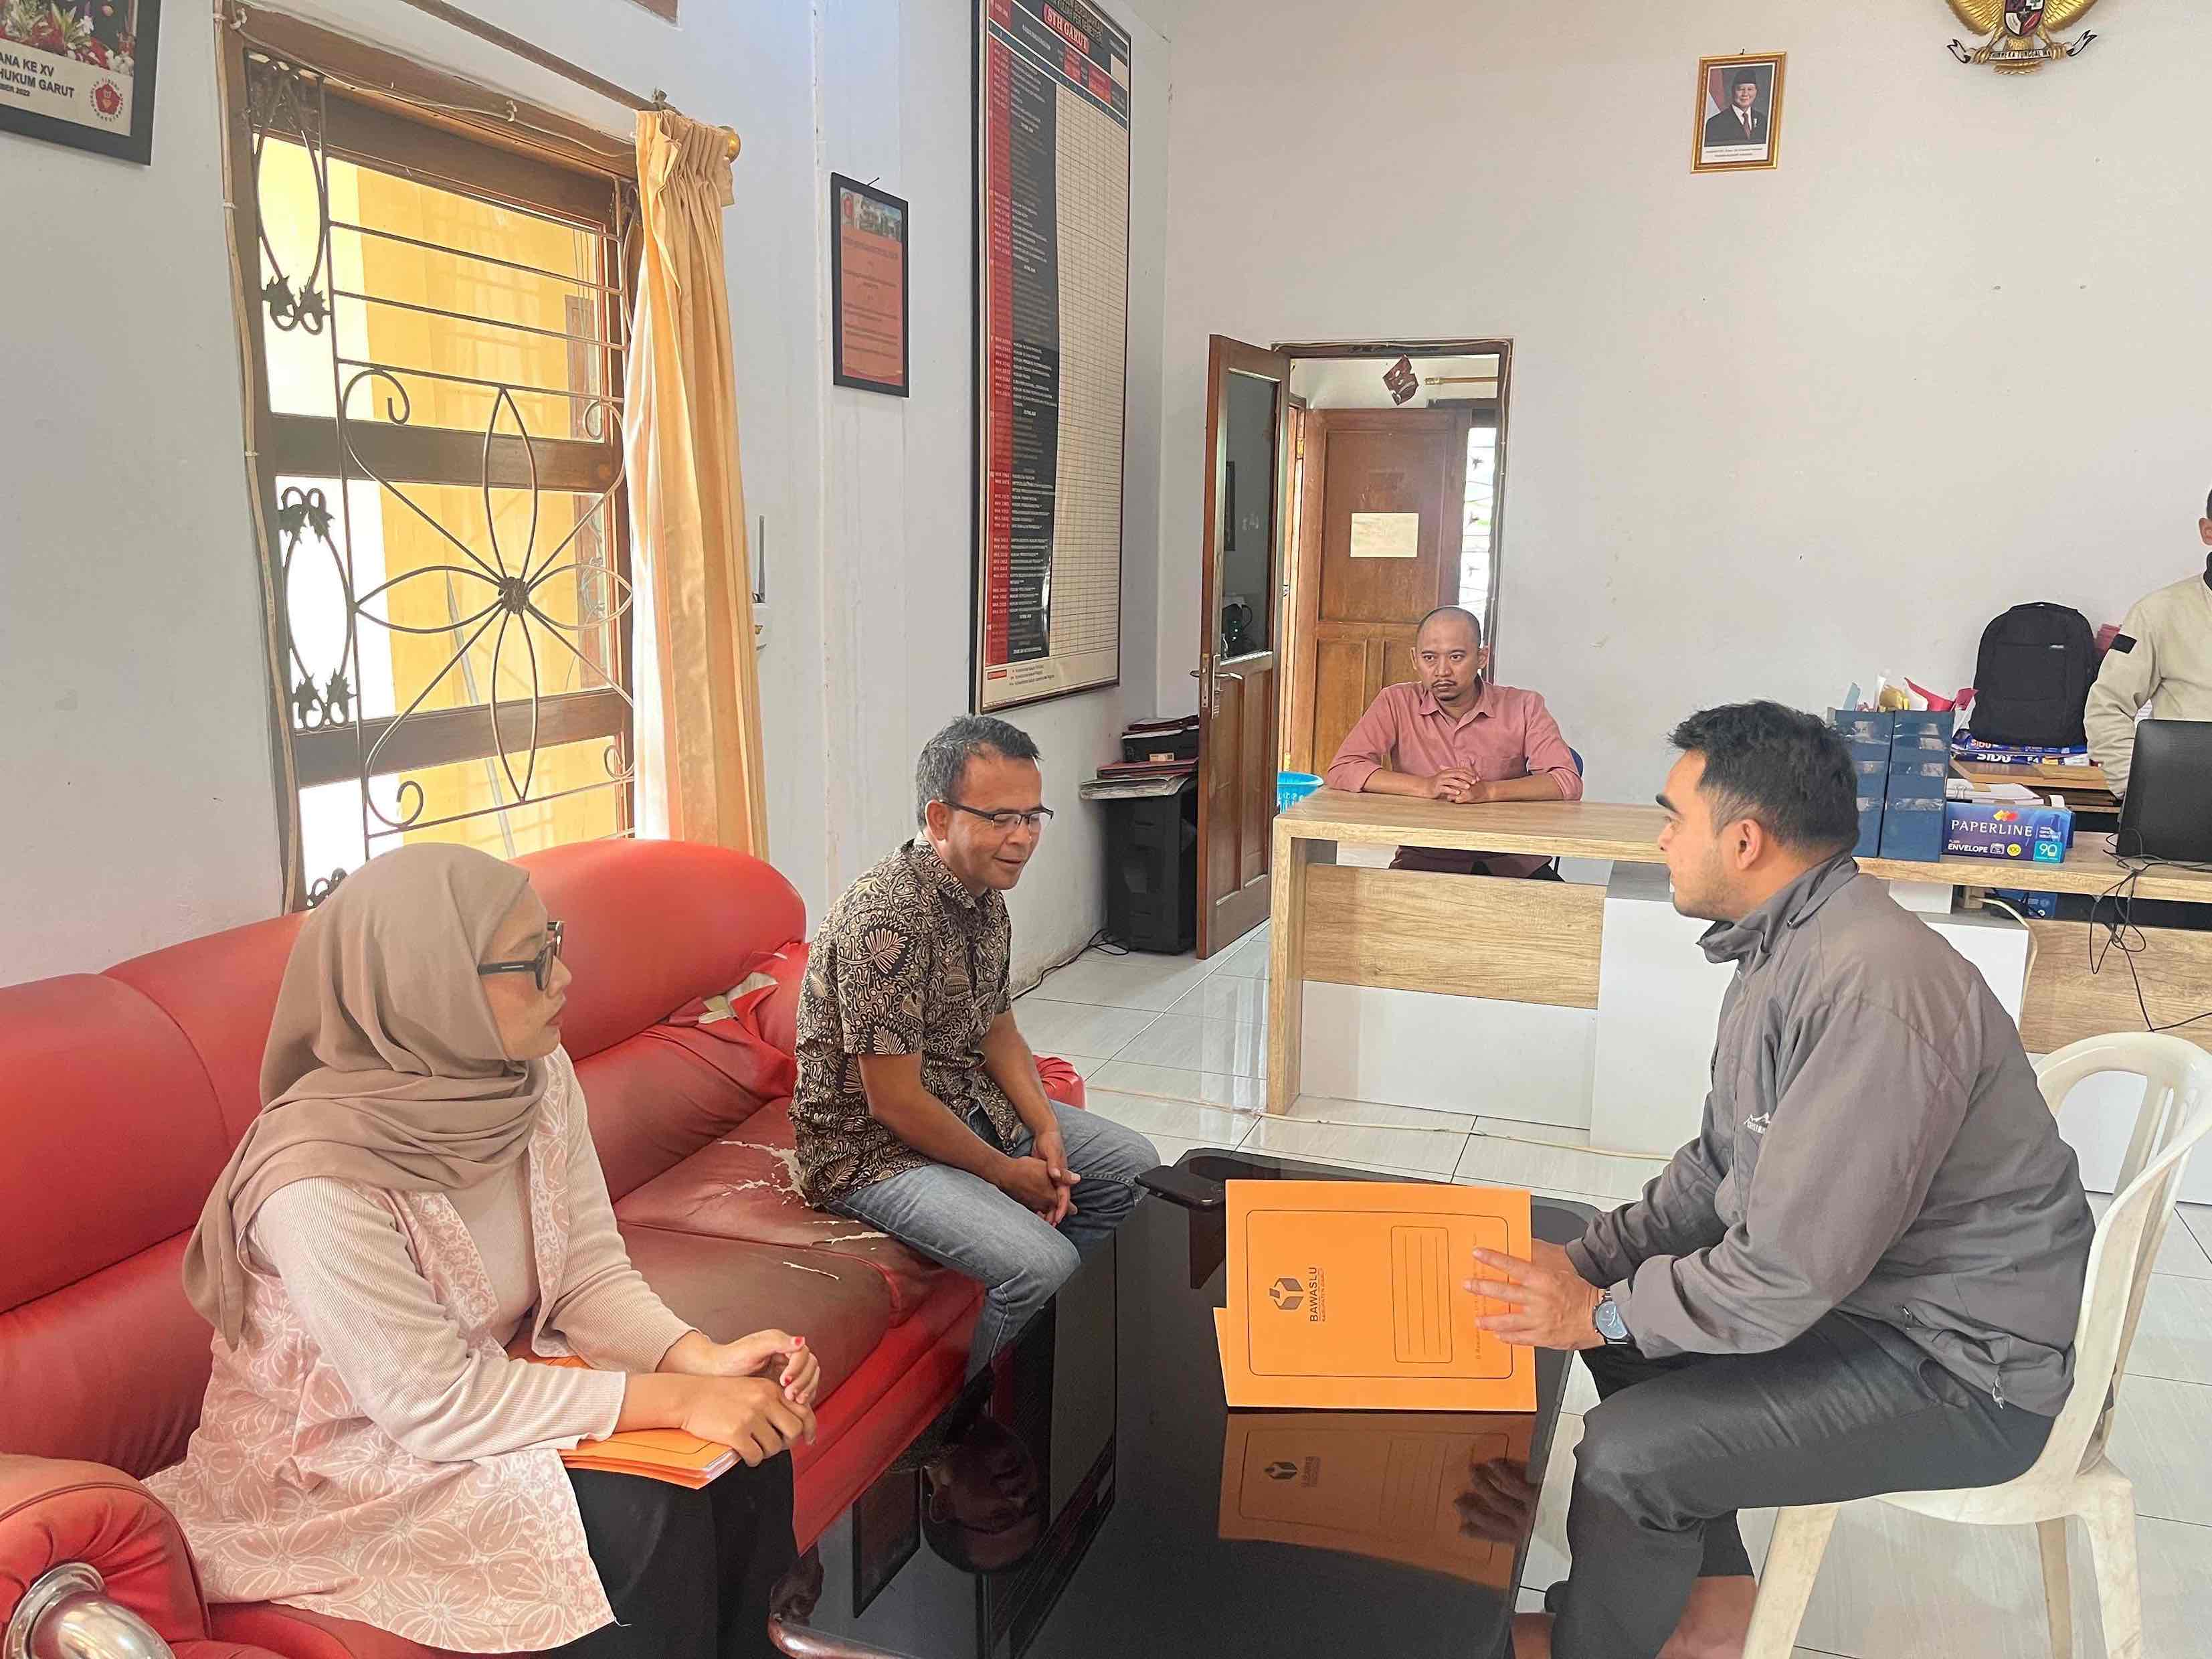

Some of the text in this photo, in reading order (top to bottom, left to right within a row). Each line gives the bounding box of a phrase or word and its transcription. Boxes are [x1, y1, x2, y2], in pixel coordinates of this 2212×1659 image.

[1048, 8, 1064, 27] STH
[1064, 21, 1089, 50] GARUT
[23, 58, 37, 74] KE
[40, 64, 54, 77] XV
[38, 79, 75, 98] GARUT
[1970, 739, 1992, 749] SIDU
[1950, 819, 2034, 837] PAPERLINE
[1948, 843, 1989, 853] ENVELOPE
[2039, 843, 2057, 857] 90
[1308, 1267, 1318, 1322] BAWASLU
